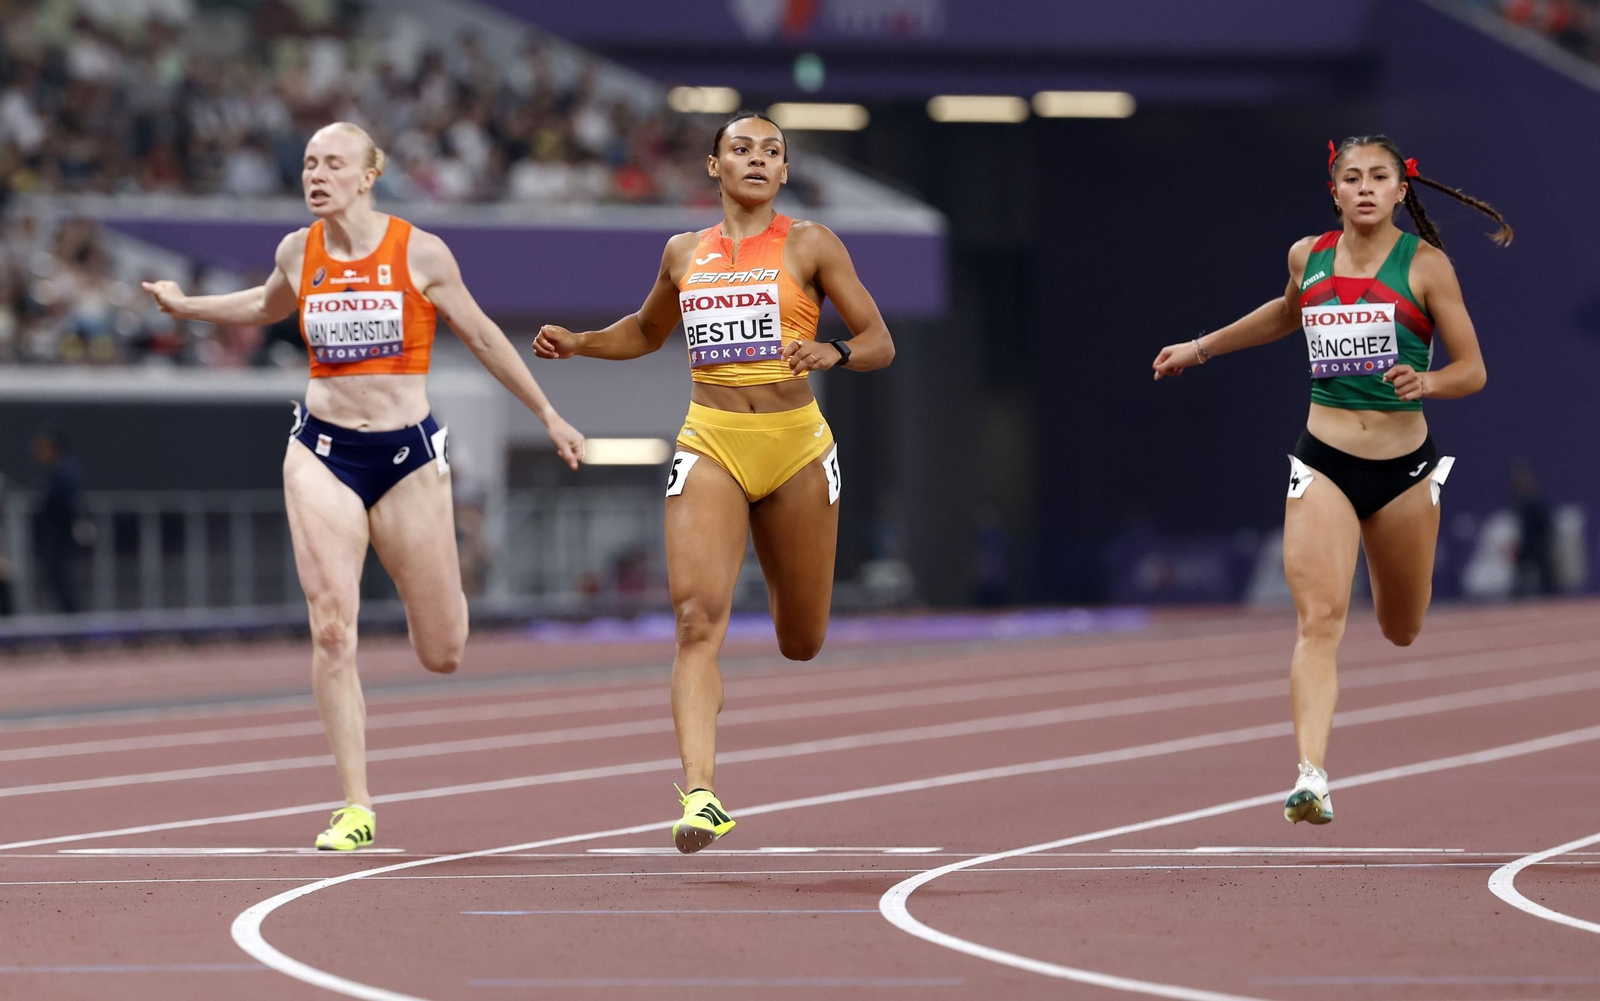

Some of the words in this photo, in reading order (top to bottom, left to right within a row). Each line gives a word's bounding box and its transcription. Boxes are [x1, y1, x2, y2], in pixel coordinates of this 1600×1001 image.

[687, 268, 780, 286] ESPAÑA
[308, 299, 398, 313] HONDA
[681, 292, 777, 313] HONDA
[687, 313, 774, 346] BESTUÉ
[1304, 311, 1392, 327] HONDA
[329, 320, 400, 342] HUNENSTIJN
[1311, 335, 1392, 359] SÁNCHEZ
[667, 458, 683, 491] 5
